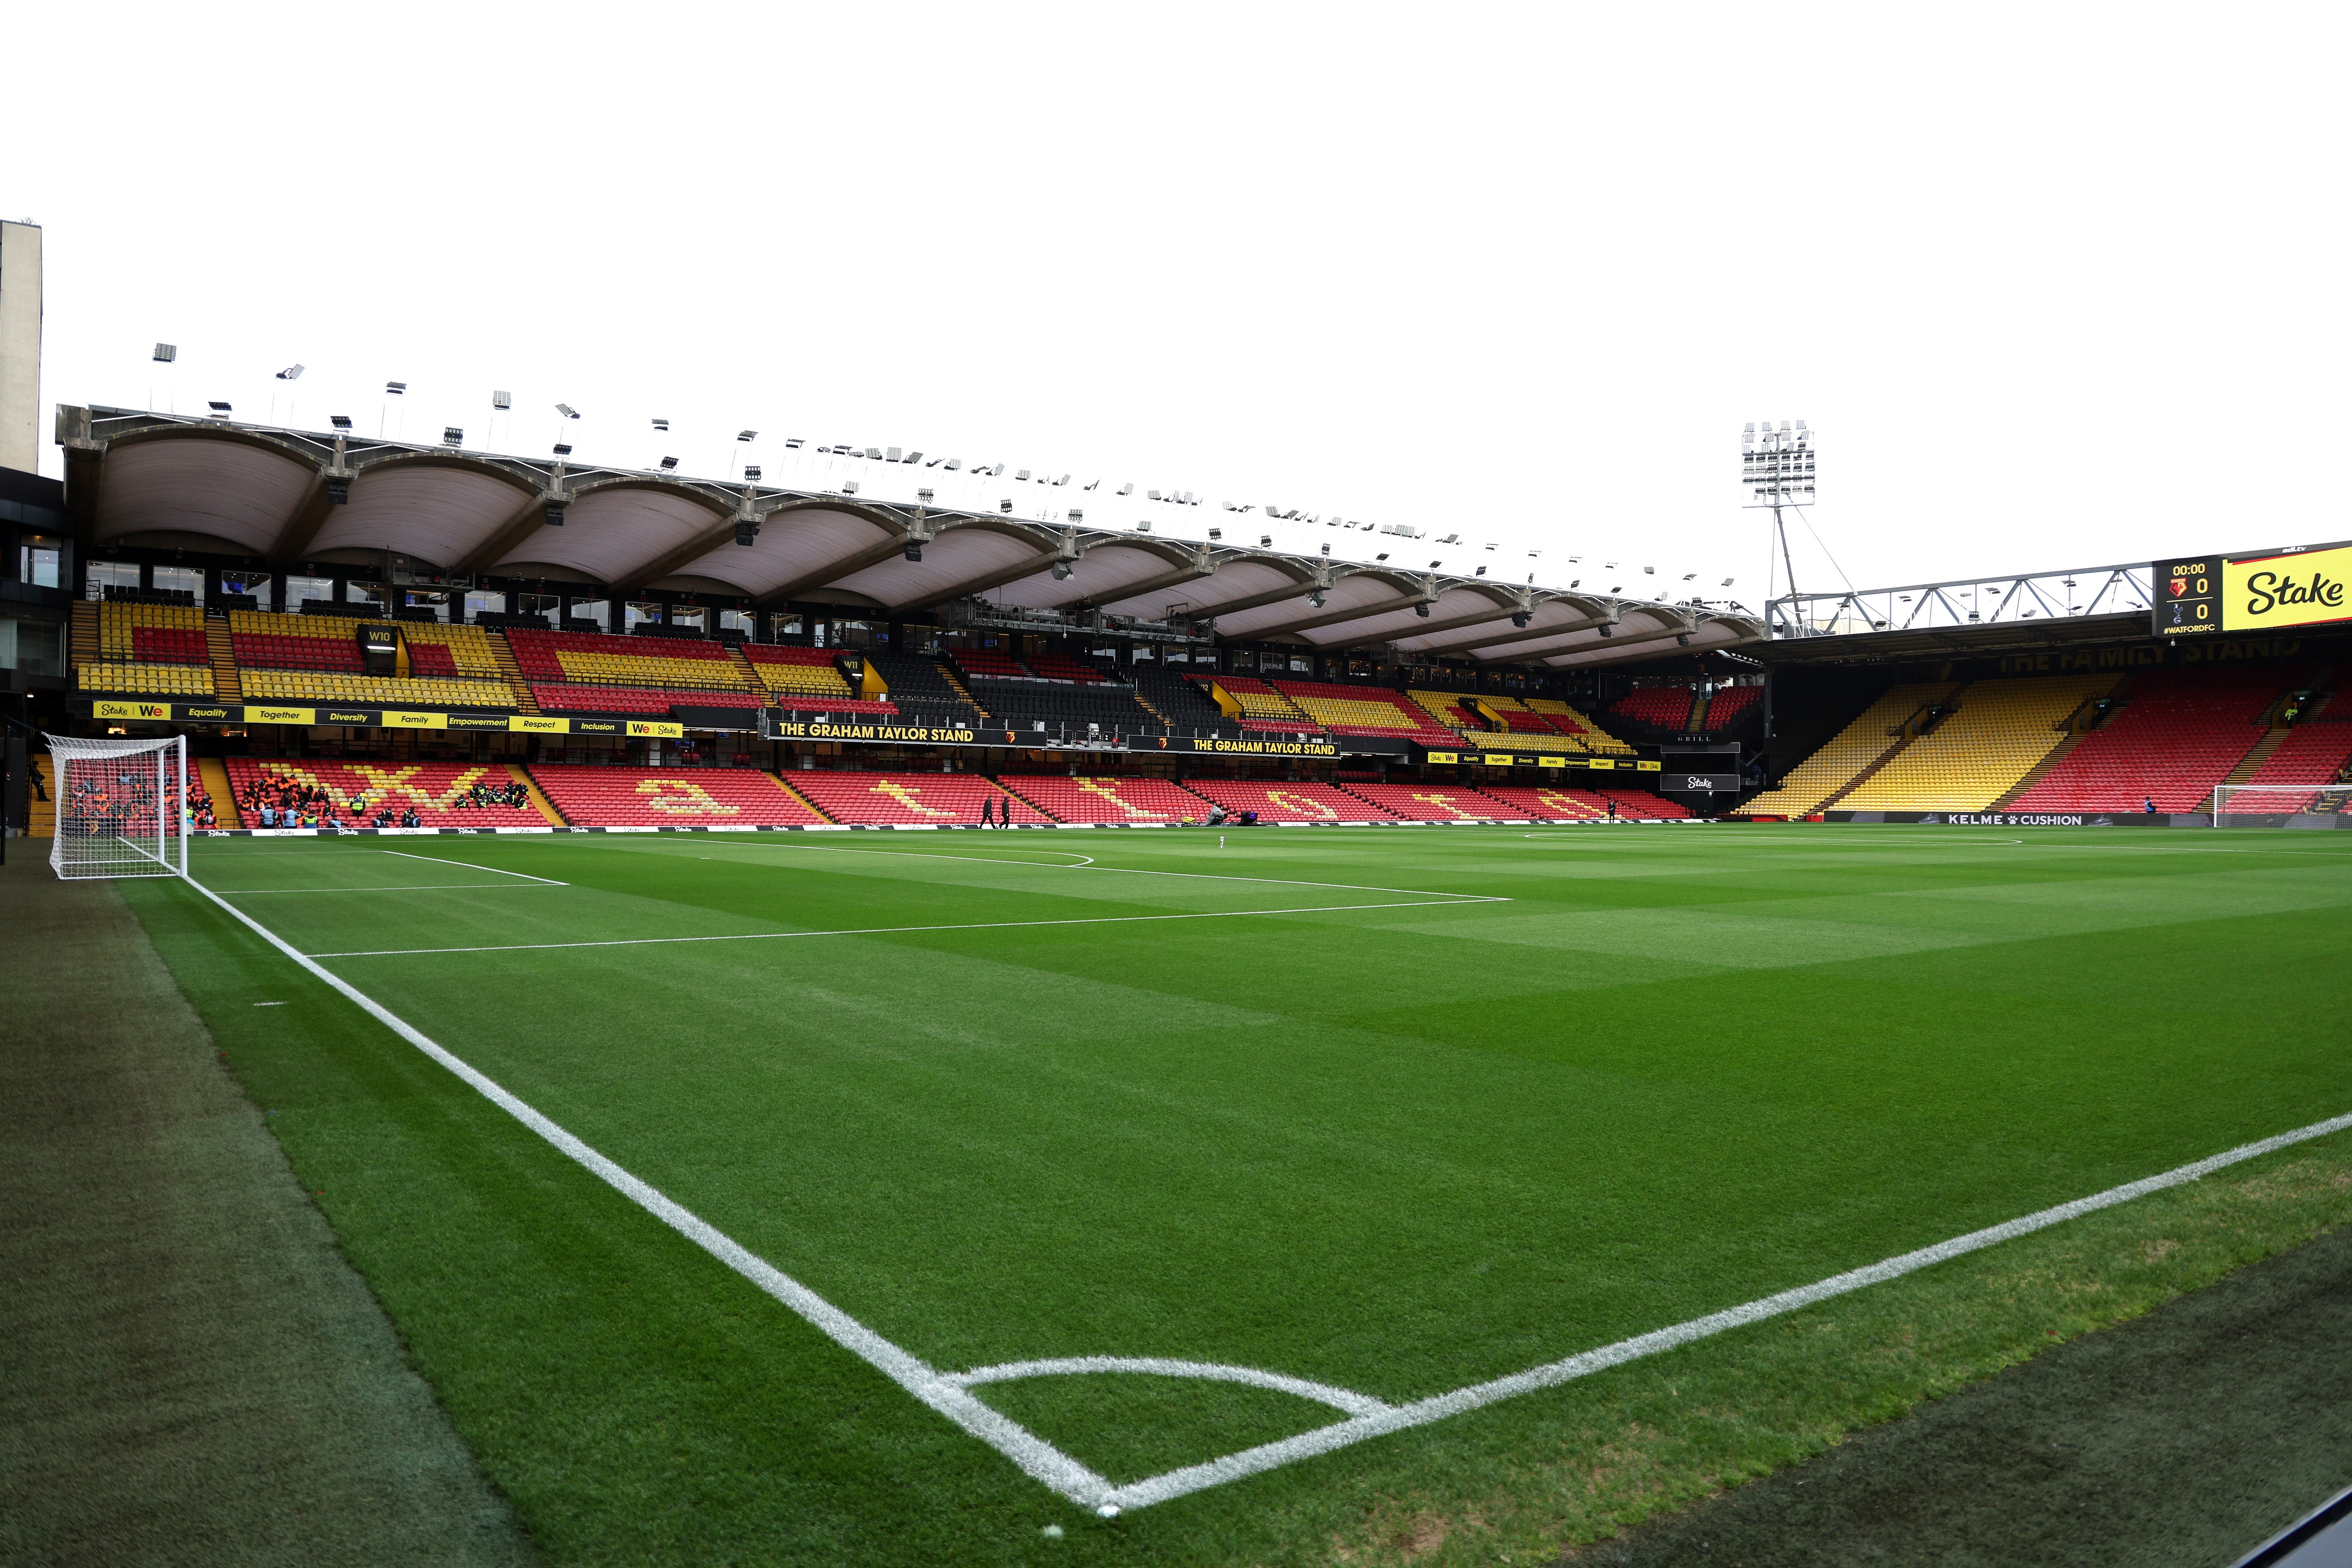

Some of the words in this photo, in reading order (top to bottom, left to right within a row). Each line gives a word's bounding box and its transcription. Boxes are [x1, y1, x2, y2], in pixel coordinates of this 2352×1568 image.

[2173, 563, 2205, 576] 00:00
[2196, 578, 2208, 593] 0
[2247, 572, 2343, 615] Stake
[2197, 604, 2208, 619] 0
[2164, 624, 2215, 634] #WATFORDFC
[369, 631, 390, 641] W10
[844, 661, 858, 669] W11
[101, 704, 128, 716] Stake
[139, 705, 163, 717] We
[188, 708, 227, 718] Equality
[260, 710, 300, 720] Together
[330, 713, 367, 722] Diversity
[401, 715, 428, 724] Family
[448, 717, 508, 727] Empowerment
[523, 720, 555, 729] Respect
[632, 724, 650, 733] We
[658, 725, 677, 735] Stake
[779, 722, 805, 735] THE
[809, 724, 873, 738] GRAHAM
[877, 726, 927, 740] TAYLOR
[931, 728, 973, 742] STAND
[1194, 739, 1212, 750] THE
[1215, 740, 1262, 752] GRAHAM
[1265, 742, 1302, 754] TAYLOR
[1304, 744, 1334, 755] STAND
[1688, 777, 1712, 789] Stake
[1949, 815, 2003, 824] KELME
[2021, 815, 2082, 825] CUSHION
